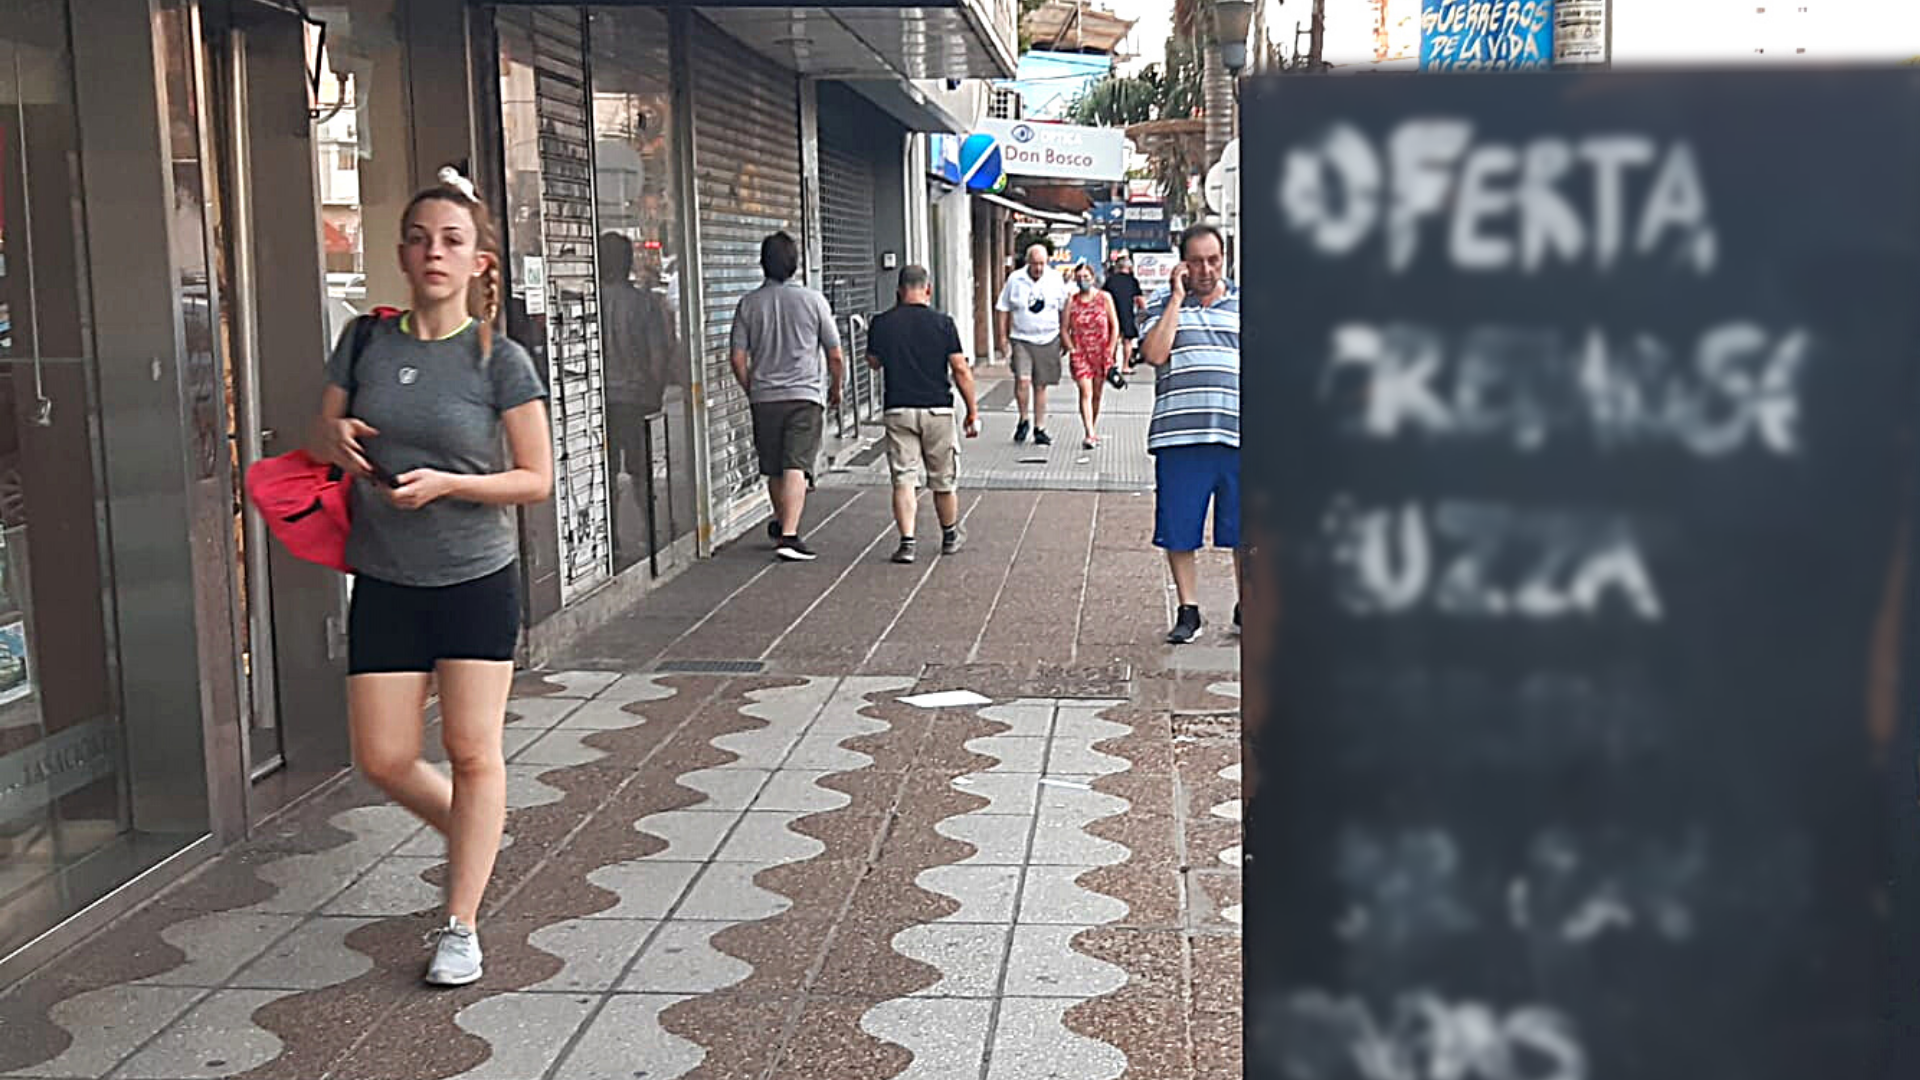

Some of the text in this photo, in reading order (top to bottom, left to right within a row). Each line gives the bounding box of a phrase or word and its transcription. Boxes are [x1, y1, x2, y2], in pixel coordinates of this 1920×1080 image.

[1005, 145, 1093, 167] Don Bosco
[1281, 121, 1714, 272] OFERTA
